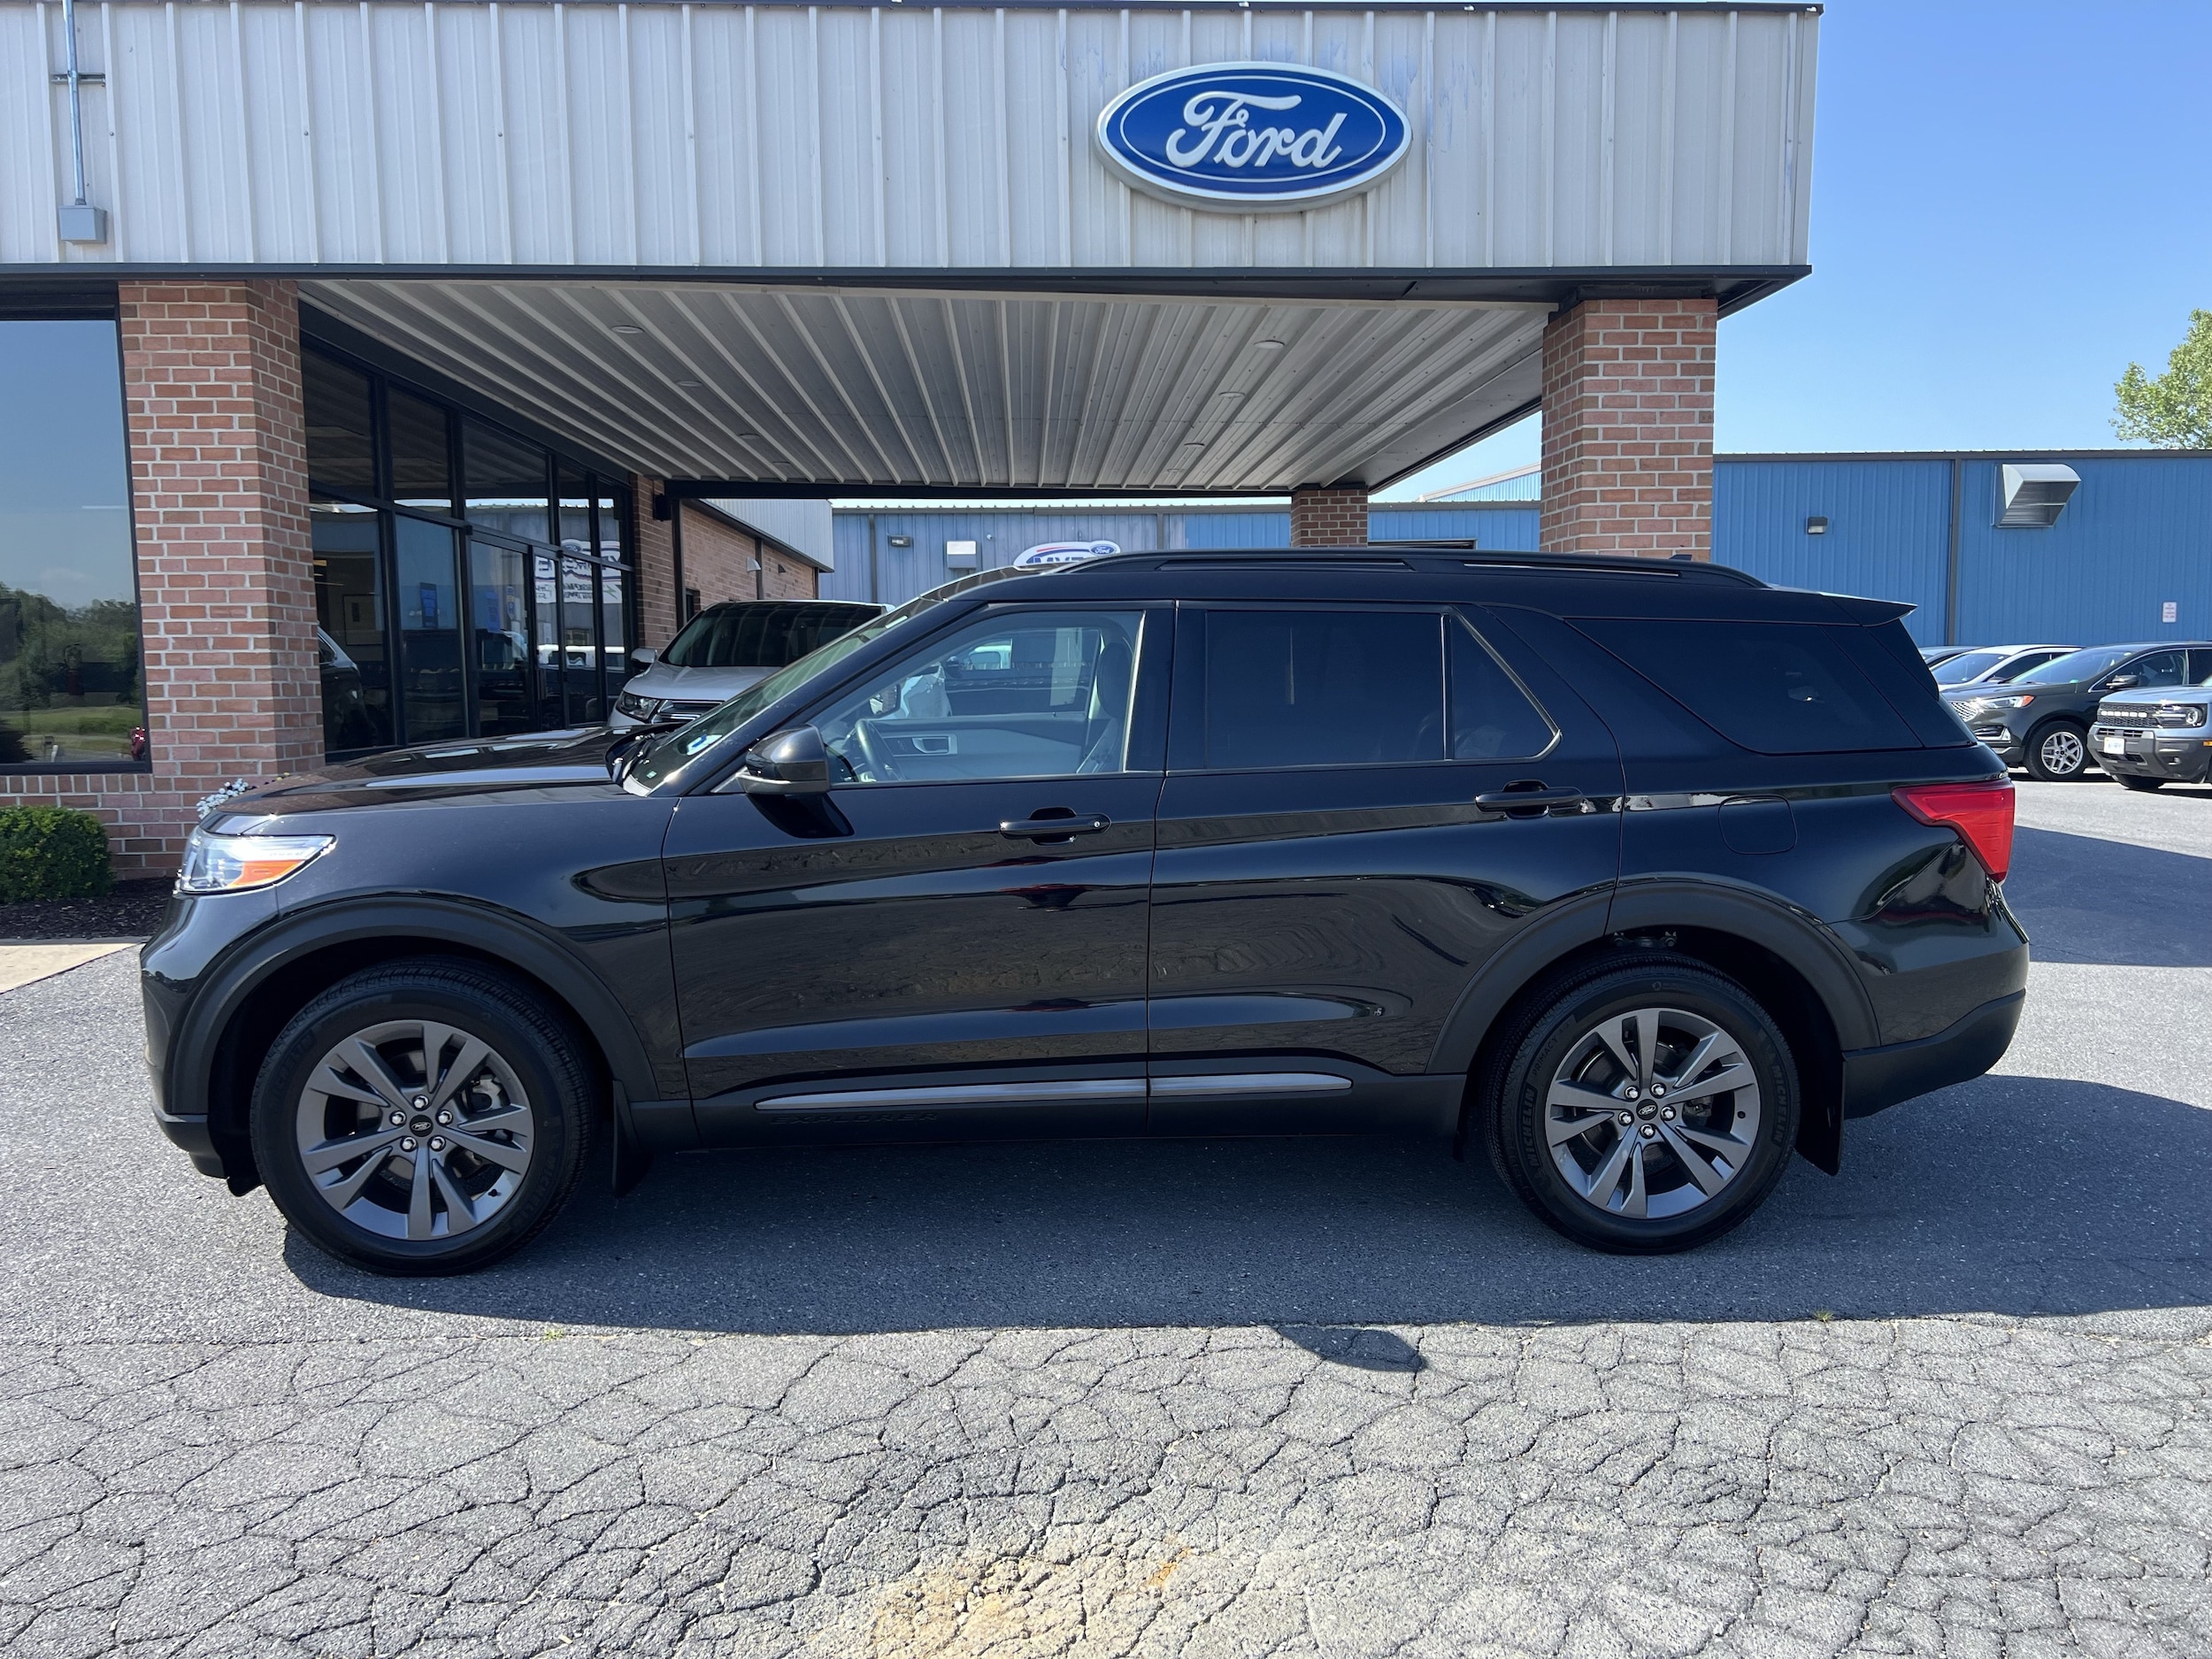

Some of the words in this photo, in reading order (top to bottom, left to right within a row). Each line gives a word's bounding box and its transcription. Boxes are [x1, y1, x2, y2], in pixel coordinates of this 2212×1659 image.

[1165, 90, 1348, 168] Ford
[1532, 1034, 1558, 1077] PRIMACY
[770, 1112, 939, 1125] EXPLORER
[1522, 1087, 1540, 1167] MICHELIN
